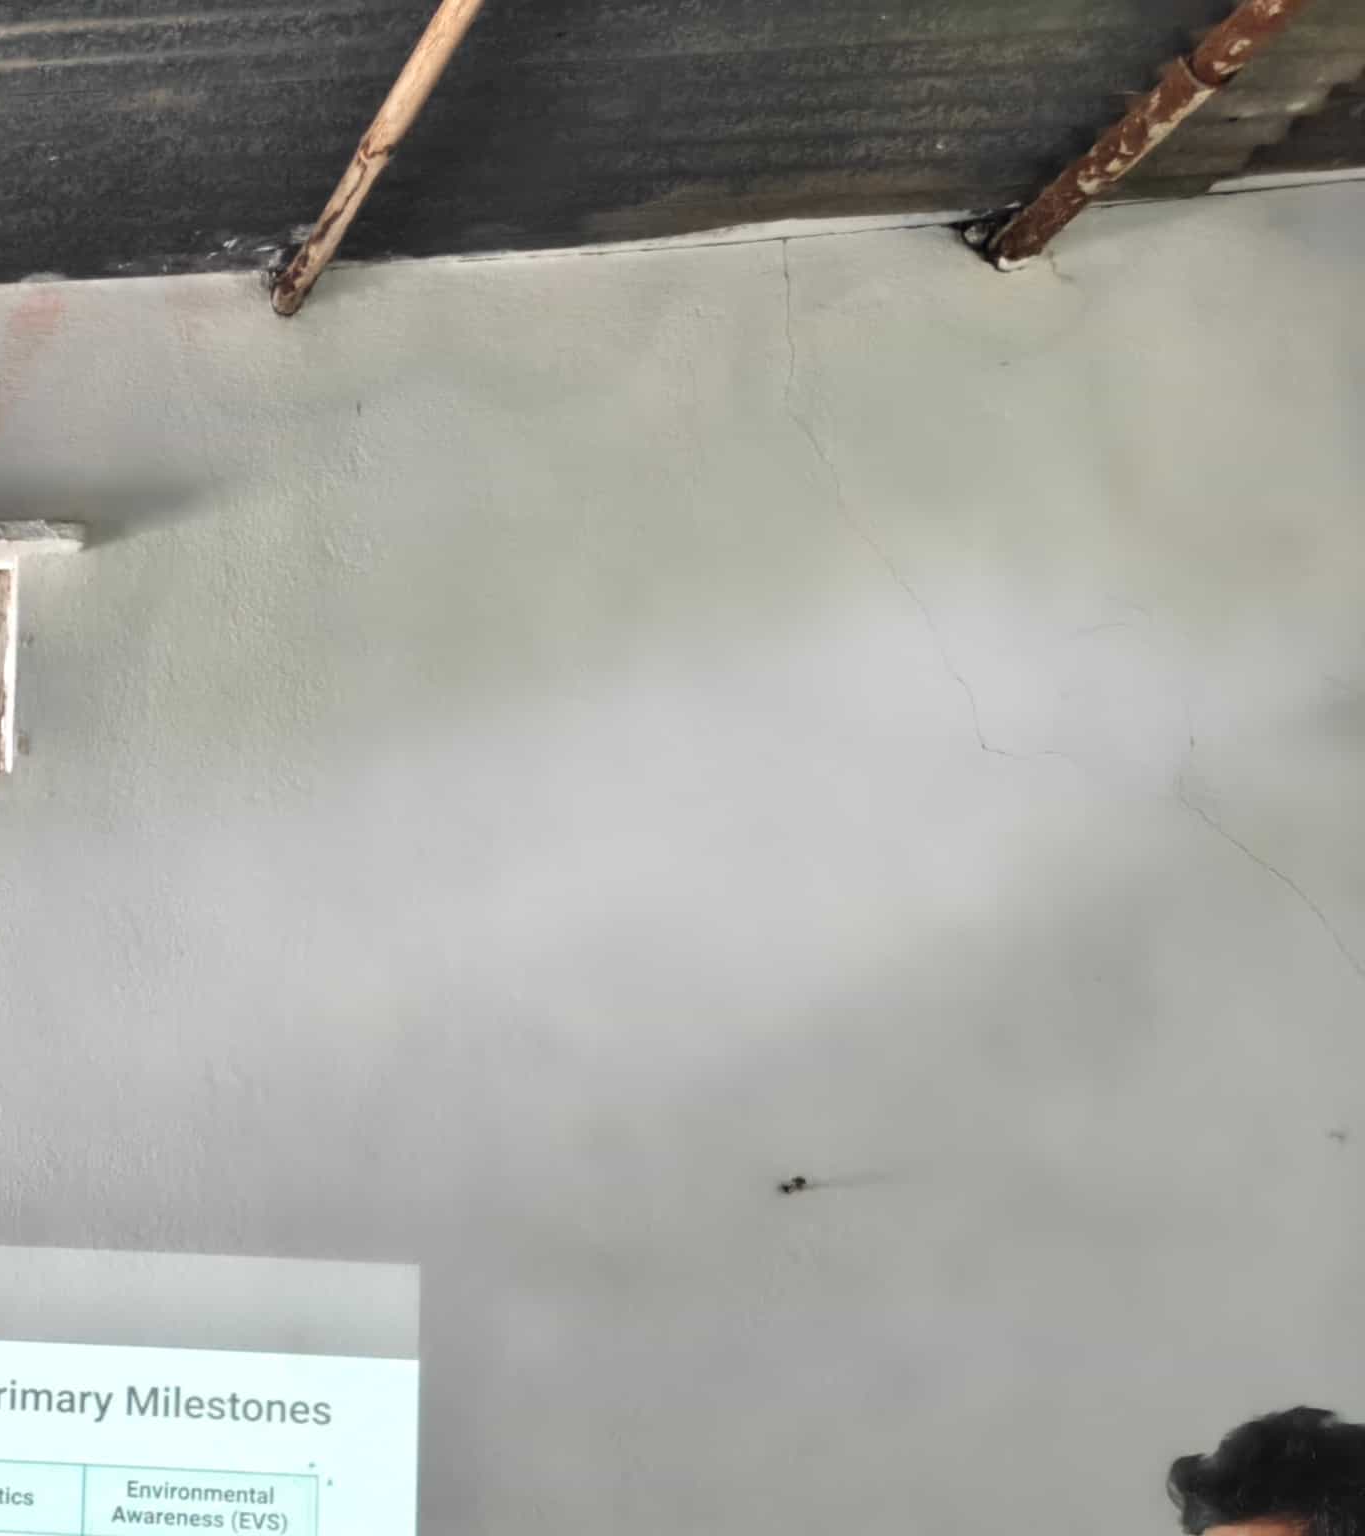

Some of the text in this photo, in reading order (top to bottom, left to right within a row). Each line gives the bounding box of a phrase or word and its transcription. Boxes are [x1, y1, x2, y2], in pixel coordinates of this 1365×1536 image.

[126, 1385, 333, 1426] Milestones
[126, 1480, 274, 1505] Environmental
[111, 1506, 288, 1535] Awareness (EVS)
